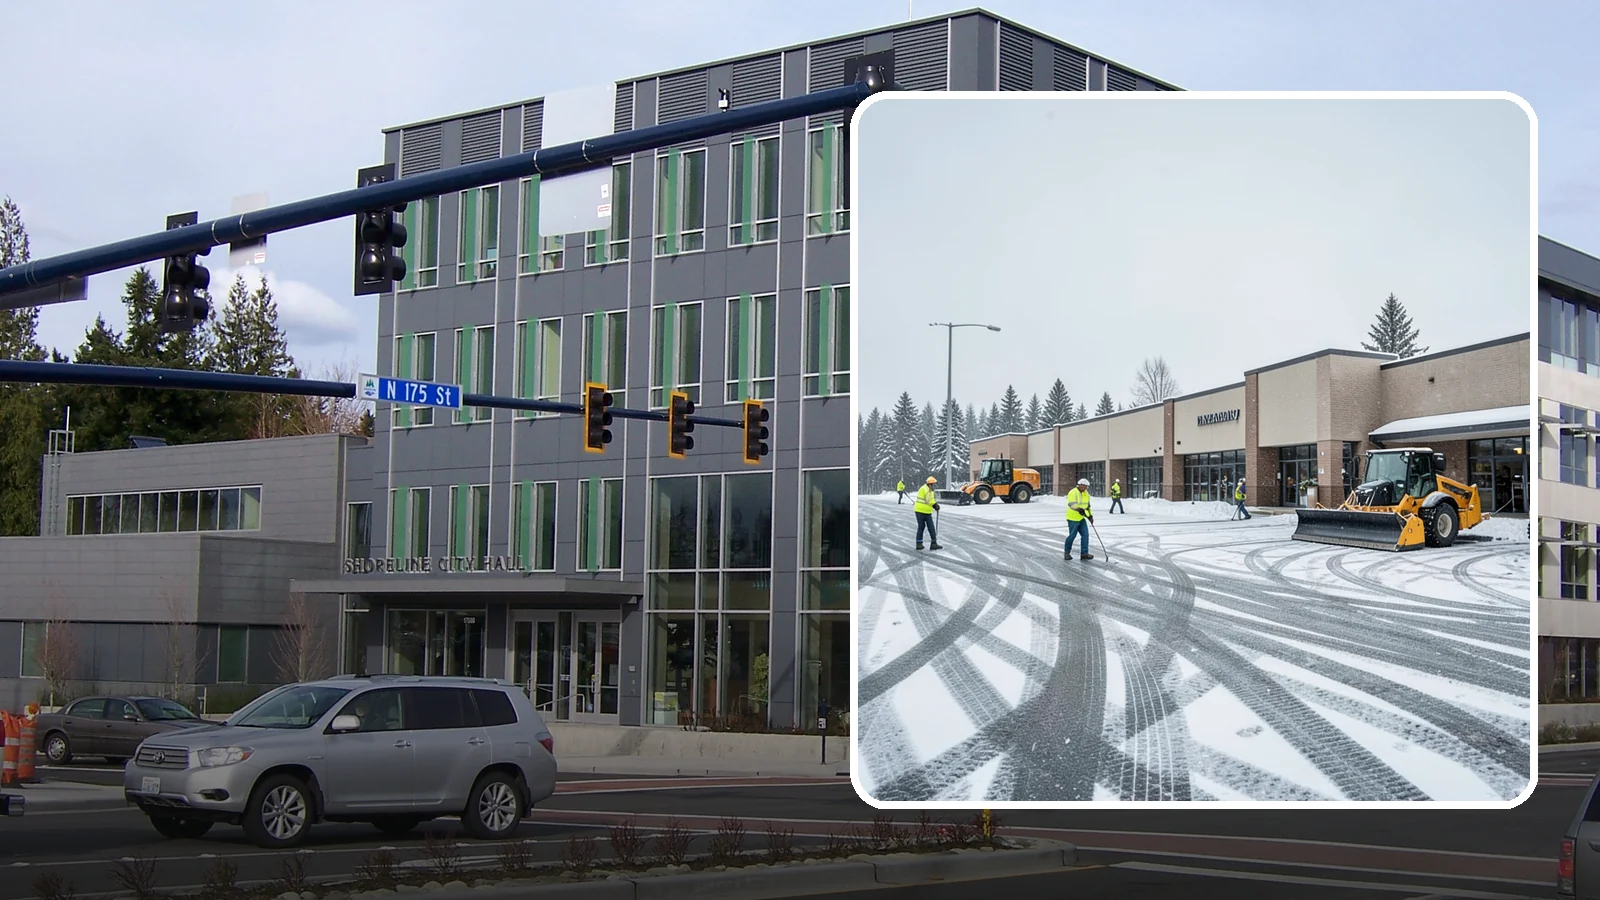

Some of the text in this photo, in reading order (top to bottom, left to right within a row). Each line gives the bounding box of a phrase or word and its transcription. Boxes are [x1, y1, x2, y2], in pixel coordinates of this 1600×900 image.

[387, 380, 451, 406] N 175 St
[343, 556, 526, 574] SHORELINE CITY HALL
